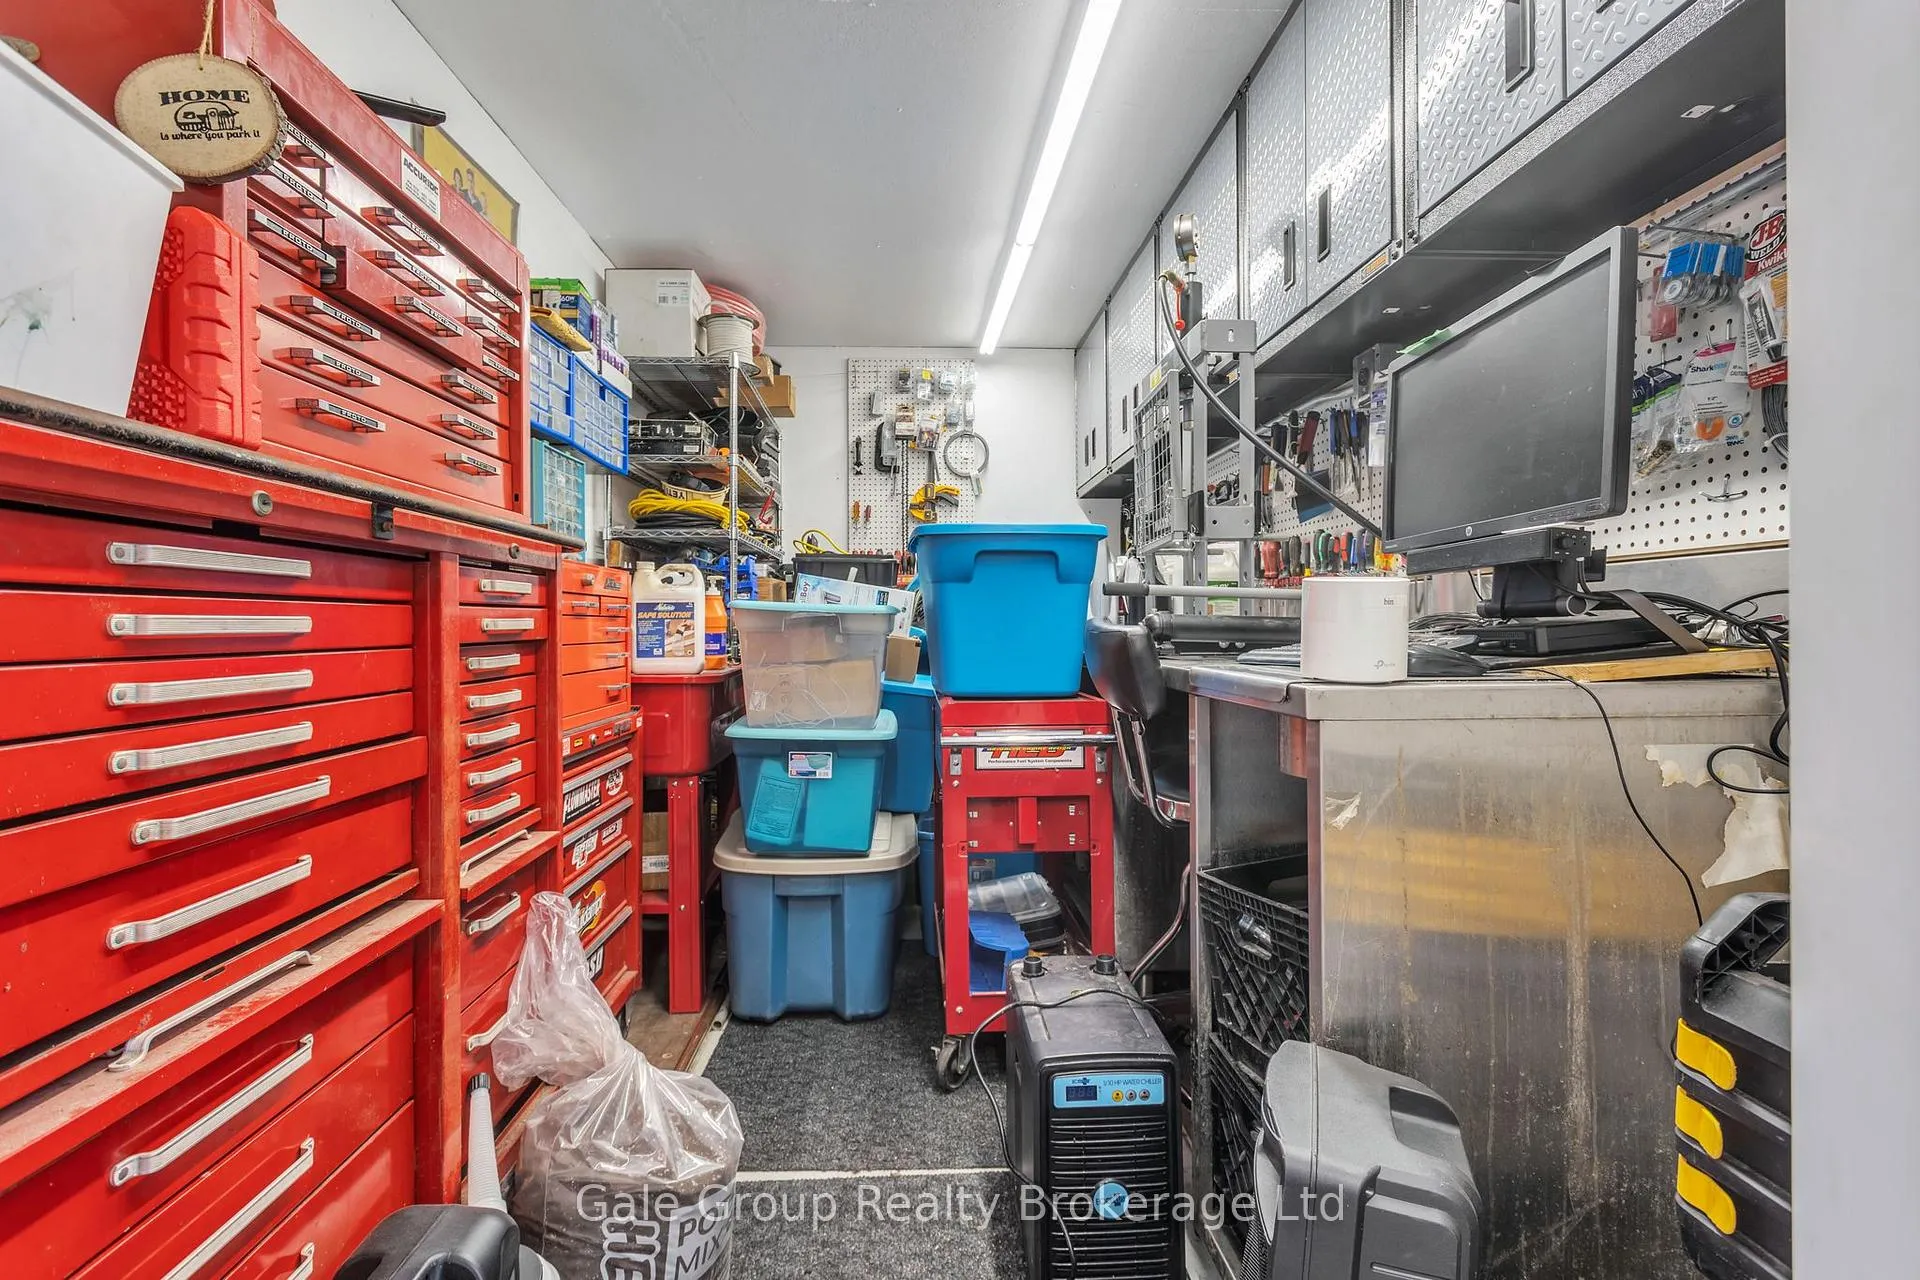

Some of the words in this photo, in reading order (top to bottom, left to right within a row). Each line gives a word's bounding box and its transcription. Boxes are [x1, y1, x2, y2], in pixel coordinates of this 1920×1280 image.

[158, 89, 251, 107] HOME
[171, 132, 203, 141] where
[204, 131, 225, 142] you
[226, 129, 251, 141] park
[403, 156, 439, 196] ACCURIDE
[1750, 236, 1781, 260] WELD
[1757, 247, 1787, 272] Kwik
[637, 611, 657, 619] SAFE
[657, 611, 692, 619] SOLUTION
[1140, 1077, 1162, 1085] CHILLER
[673, 1230, 723, 1280] MIX
